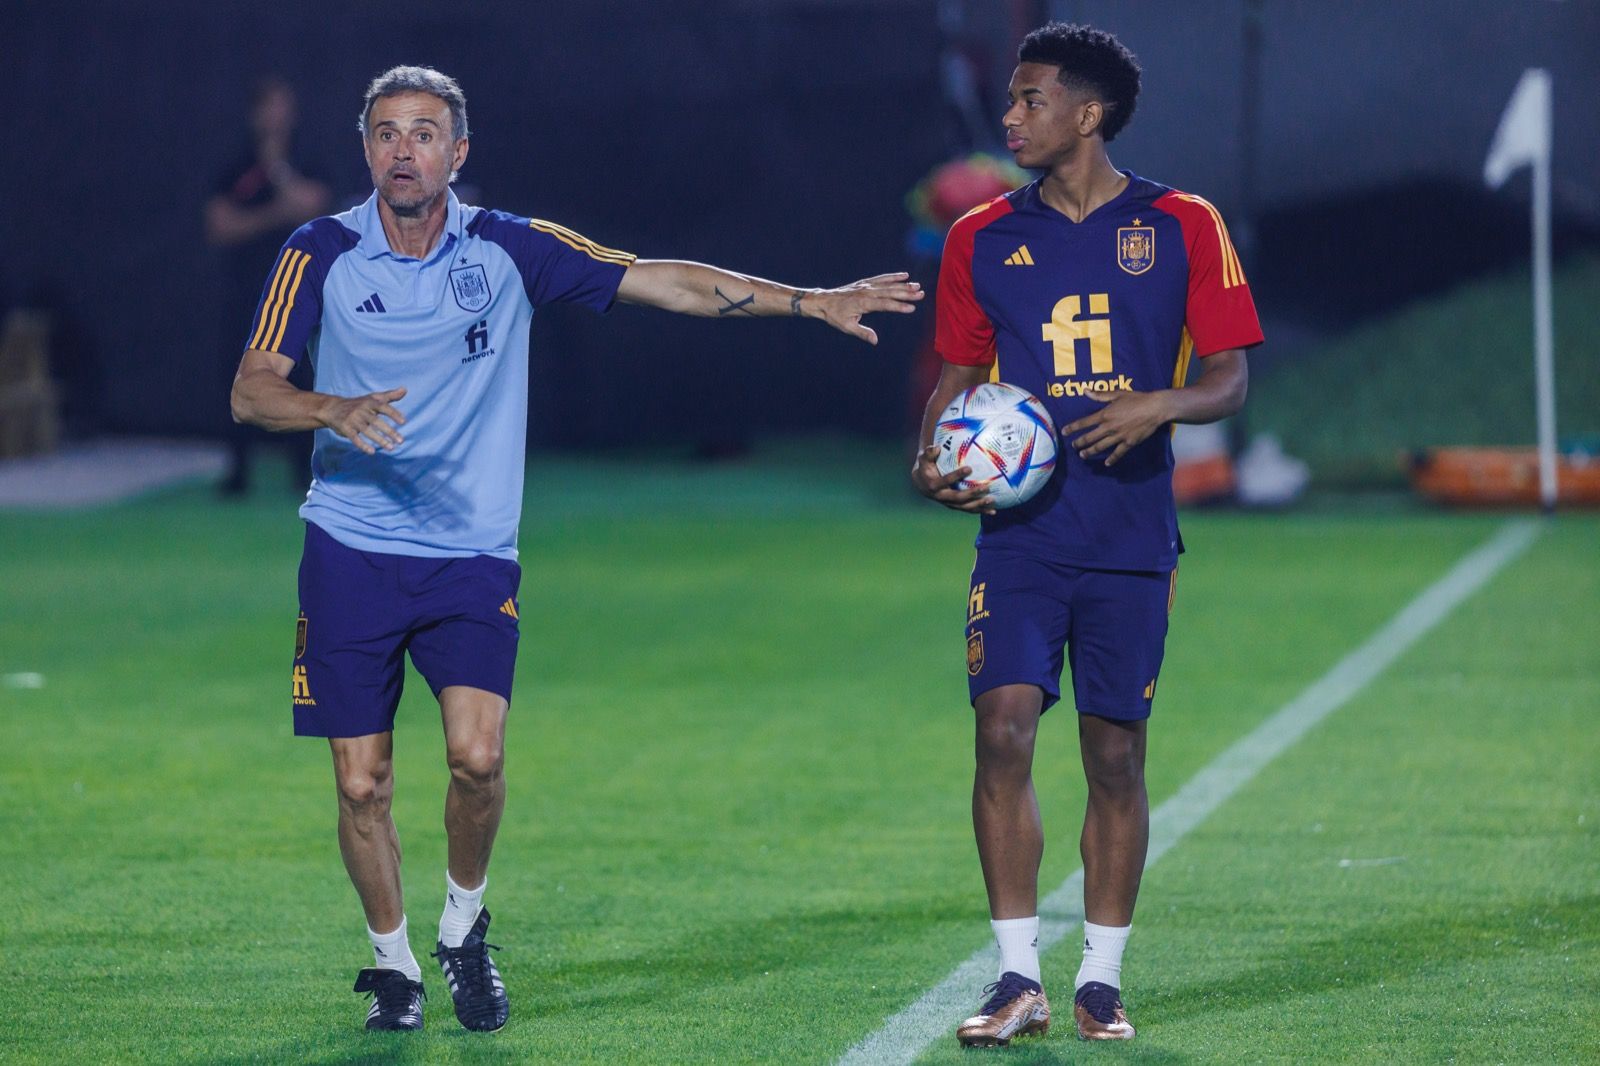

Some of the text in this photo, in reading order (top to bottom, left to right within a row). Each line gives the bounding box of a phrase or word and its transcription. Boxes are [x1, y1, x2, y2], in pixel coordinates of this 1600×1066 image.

[465, 320, 488, 354] fi
[1042, 293, 1113, 377] fi
[462, 348, 495, 364] network
[1047, 375, 1133, 397] etwork
